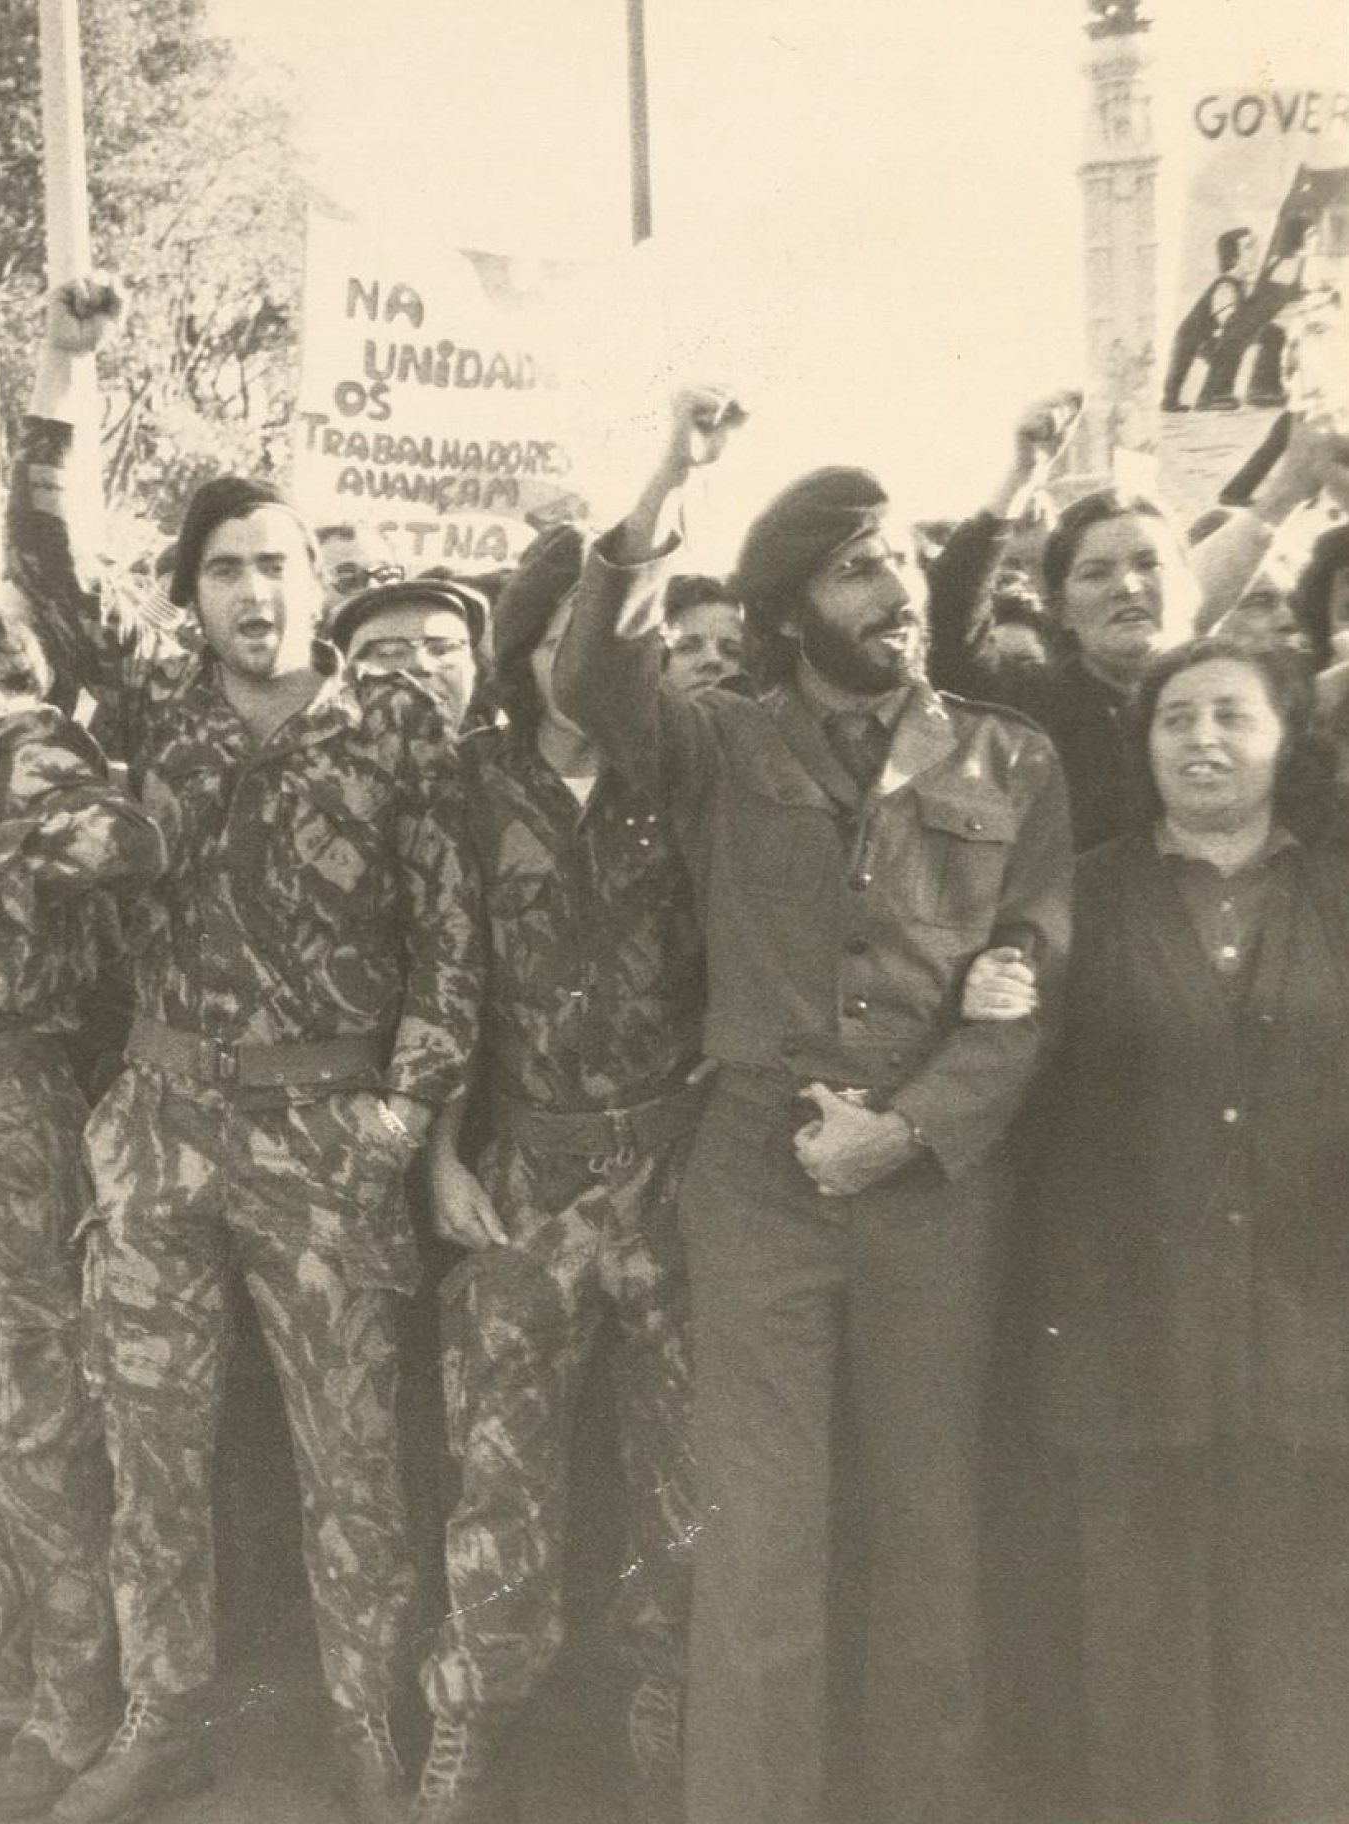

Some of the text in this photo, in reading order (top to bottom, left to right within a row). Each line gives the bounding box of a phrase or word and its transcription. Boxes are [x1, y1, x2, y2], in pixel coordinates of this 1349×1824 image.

[345, 276, 425, 330] NA
[363, 338, 561, 391] UNiDAD
[333, 380, 392, 422] OS
[300, 411, 573, 477] TRABALHADORES
